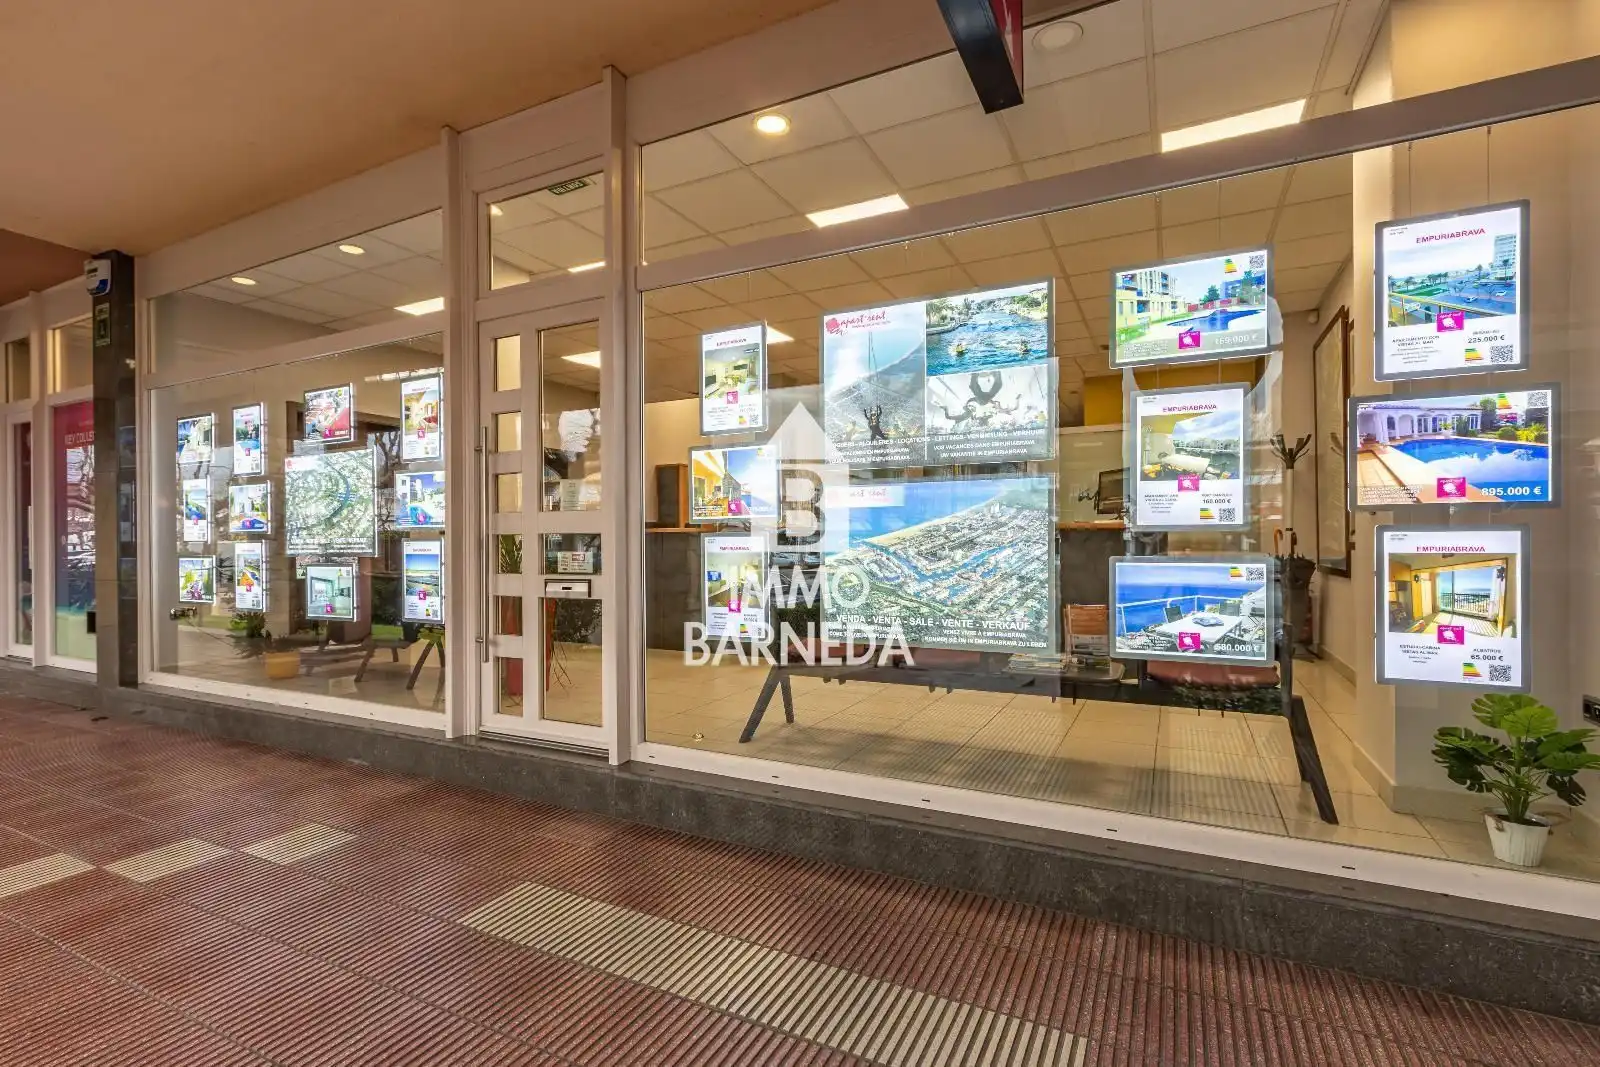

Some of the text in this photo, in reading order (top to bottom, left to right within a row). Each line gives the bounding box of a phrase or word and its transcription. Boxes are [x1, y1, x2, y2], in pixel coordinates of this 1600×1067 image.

[1415, 227, 1486, 244] EMPURIABRAVA
[1162, 404, 1217, 412] EMPURIABRAVA
[1481, 486, 1542, 496] 895.000 €
[1415, 545, 1486, 553] EMPURIABRAVA
[836, 614, 1031, 631] VENDA VENTA SALE VENTE VERKAUF
